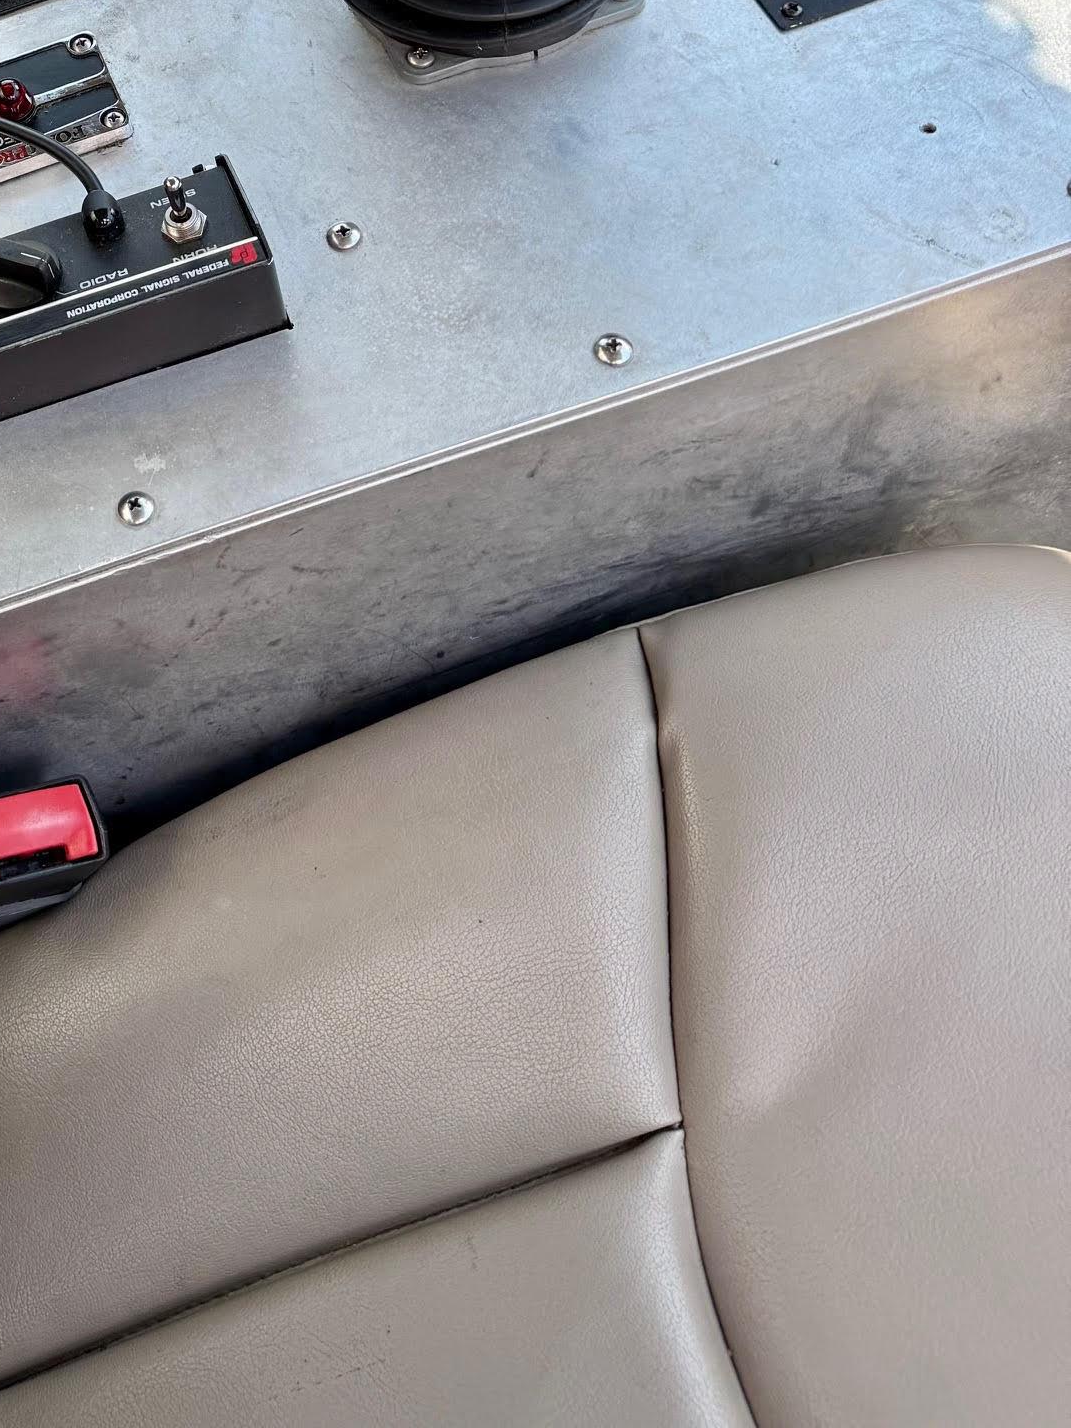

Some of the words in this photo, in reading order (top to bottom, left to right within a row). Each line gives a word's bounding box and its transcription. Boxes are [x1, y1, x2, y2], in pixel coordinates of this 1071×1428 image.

[150, 188, 196, 209] SEN
[80, 267, 129, 290] RADIO
[182, 258, 230, 279] FEDERAL
[141, 276, 181, 294] SIGNAL
[66, 289, 139, 319] CORPORATION
